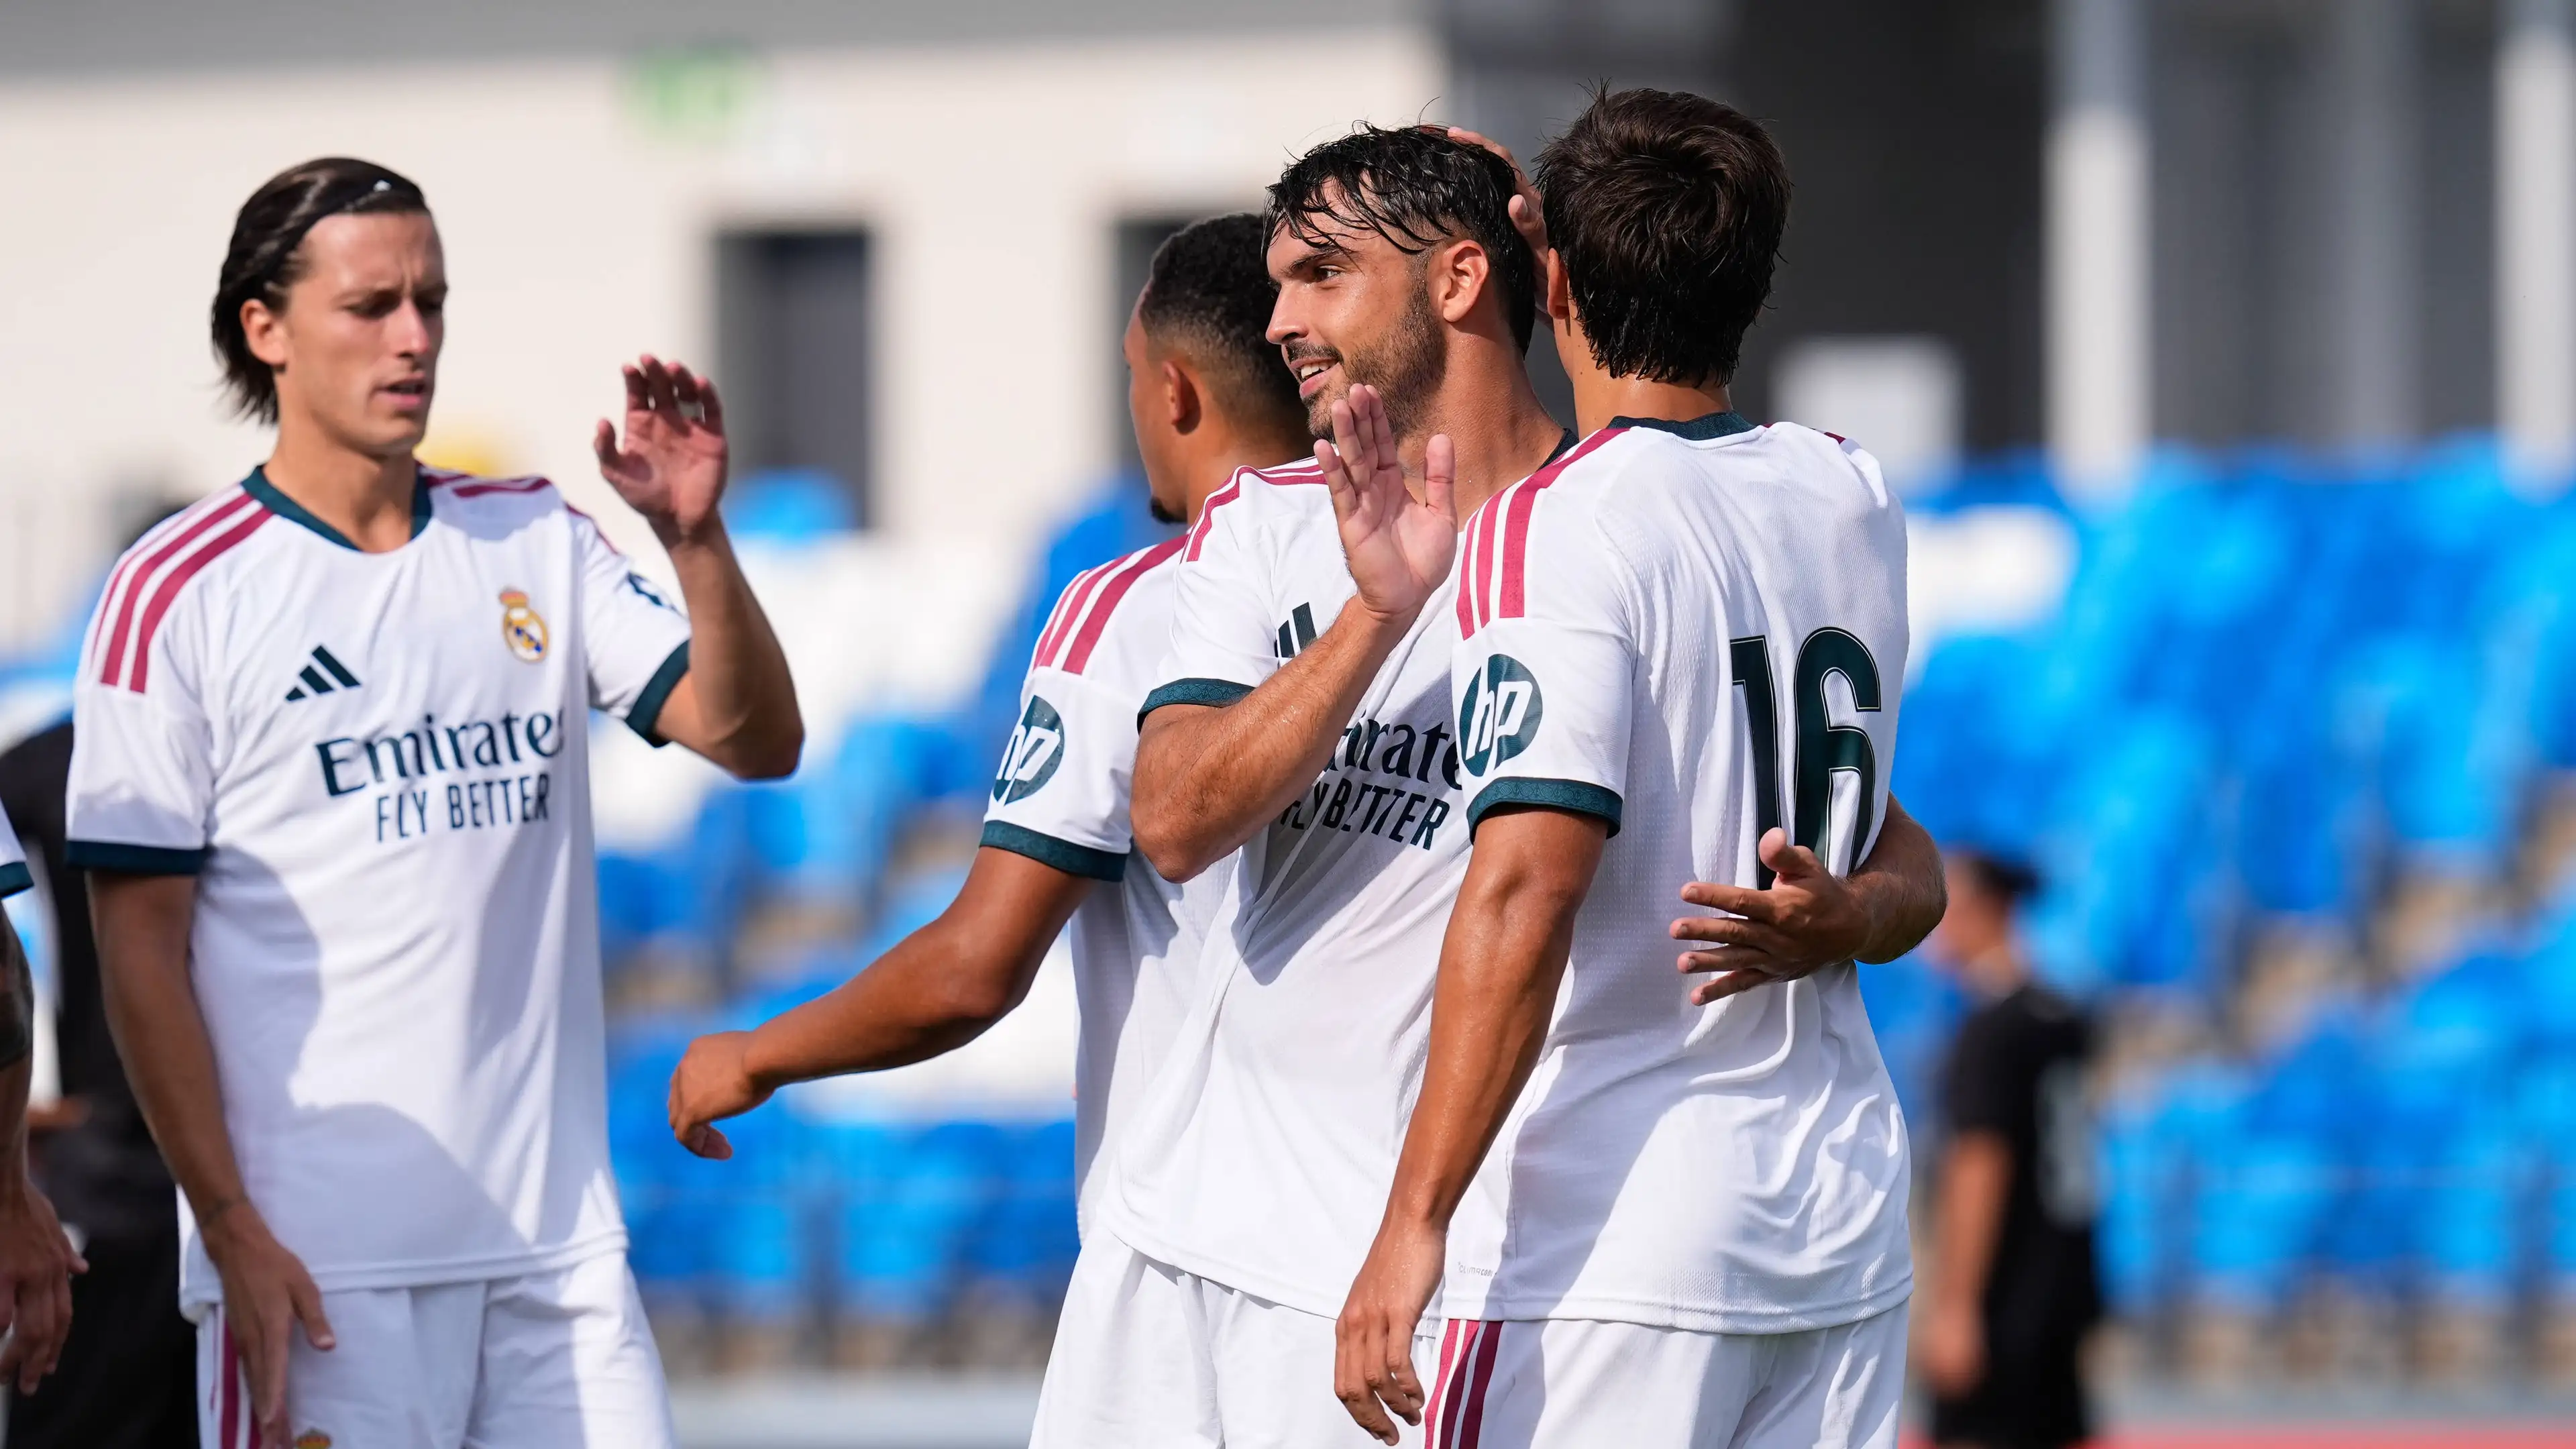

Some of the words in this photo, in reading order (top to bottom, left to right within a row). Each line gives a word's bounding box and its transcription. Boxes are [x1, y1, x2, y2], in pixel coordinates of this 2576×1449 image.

[1324, 709, 1462, 790] irate
[1460, 654, 1542, 777] hp
[1729, 626, 1881, 891] 16
[376, 790, 427, 843] FLY
[447, 773, 550, 829] BETTER
[1322, 777, 1450, 851] BETTER
